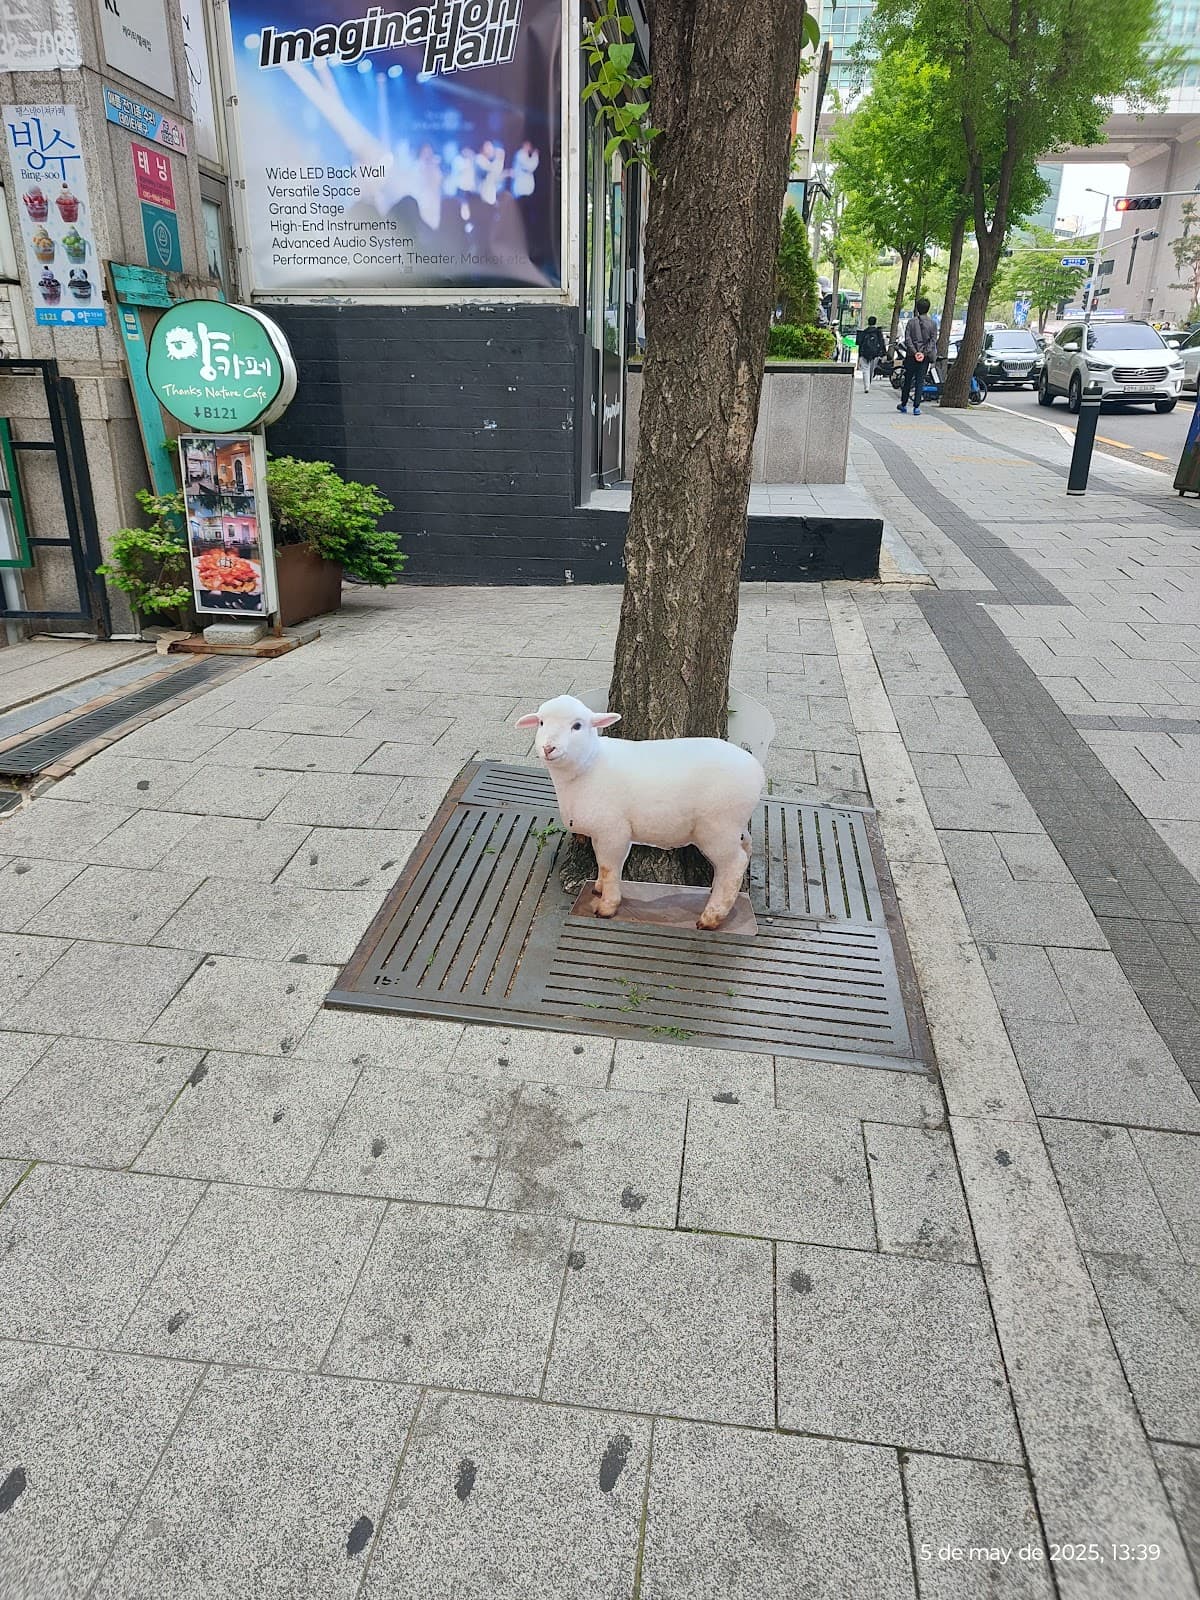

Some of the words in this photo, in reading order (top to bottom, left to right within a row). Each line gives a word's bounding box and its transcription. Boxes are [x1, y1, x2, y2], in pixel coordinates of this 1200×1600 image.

[259, 0, 521, 64] Imagination
[423, 23, 520, 75] Hall
[8, 117, 81, 181] 빙수
[21, 169, 60, 182] Bing-soo
[265, 167, 297, 180] Wide
[300, 167, 323, 179] LED
[327, 166, 357, 179] Back
[359, 165, 385, 178] Wall
[267, 185, 320, 198] Versatile
[322, 184, 361, 200] Space
[269, 202, 307, 215] Grand
[309, 202, 345, 217] Stage
[270, 219, 325, 235] High-End
[327, 219, 397, 232] Instruments
[272, 237, 330, 249] Advanced
[333, 236, 367, 248] Audio
[369, 235, 414, 251] System
[273, 252, 350, 266] Performance,
[353, 252, 405, 266] Concert,
[407, 252, 457, 265] Theater,
[162, 384, 202, 397] Thanks
[205, 386, 241, 399] Nature
[243, 386, 267, 404] Cafe
[204, 407, 238, 420] B121
